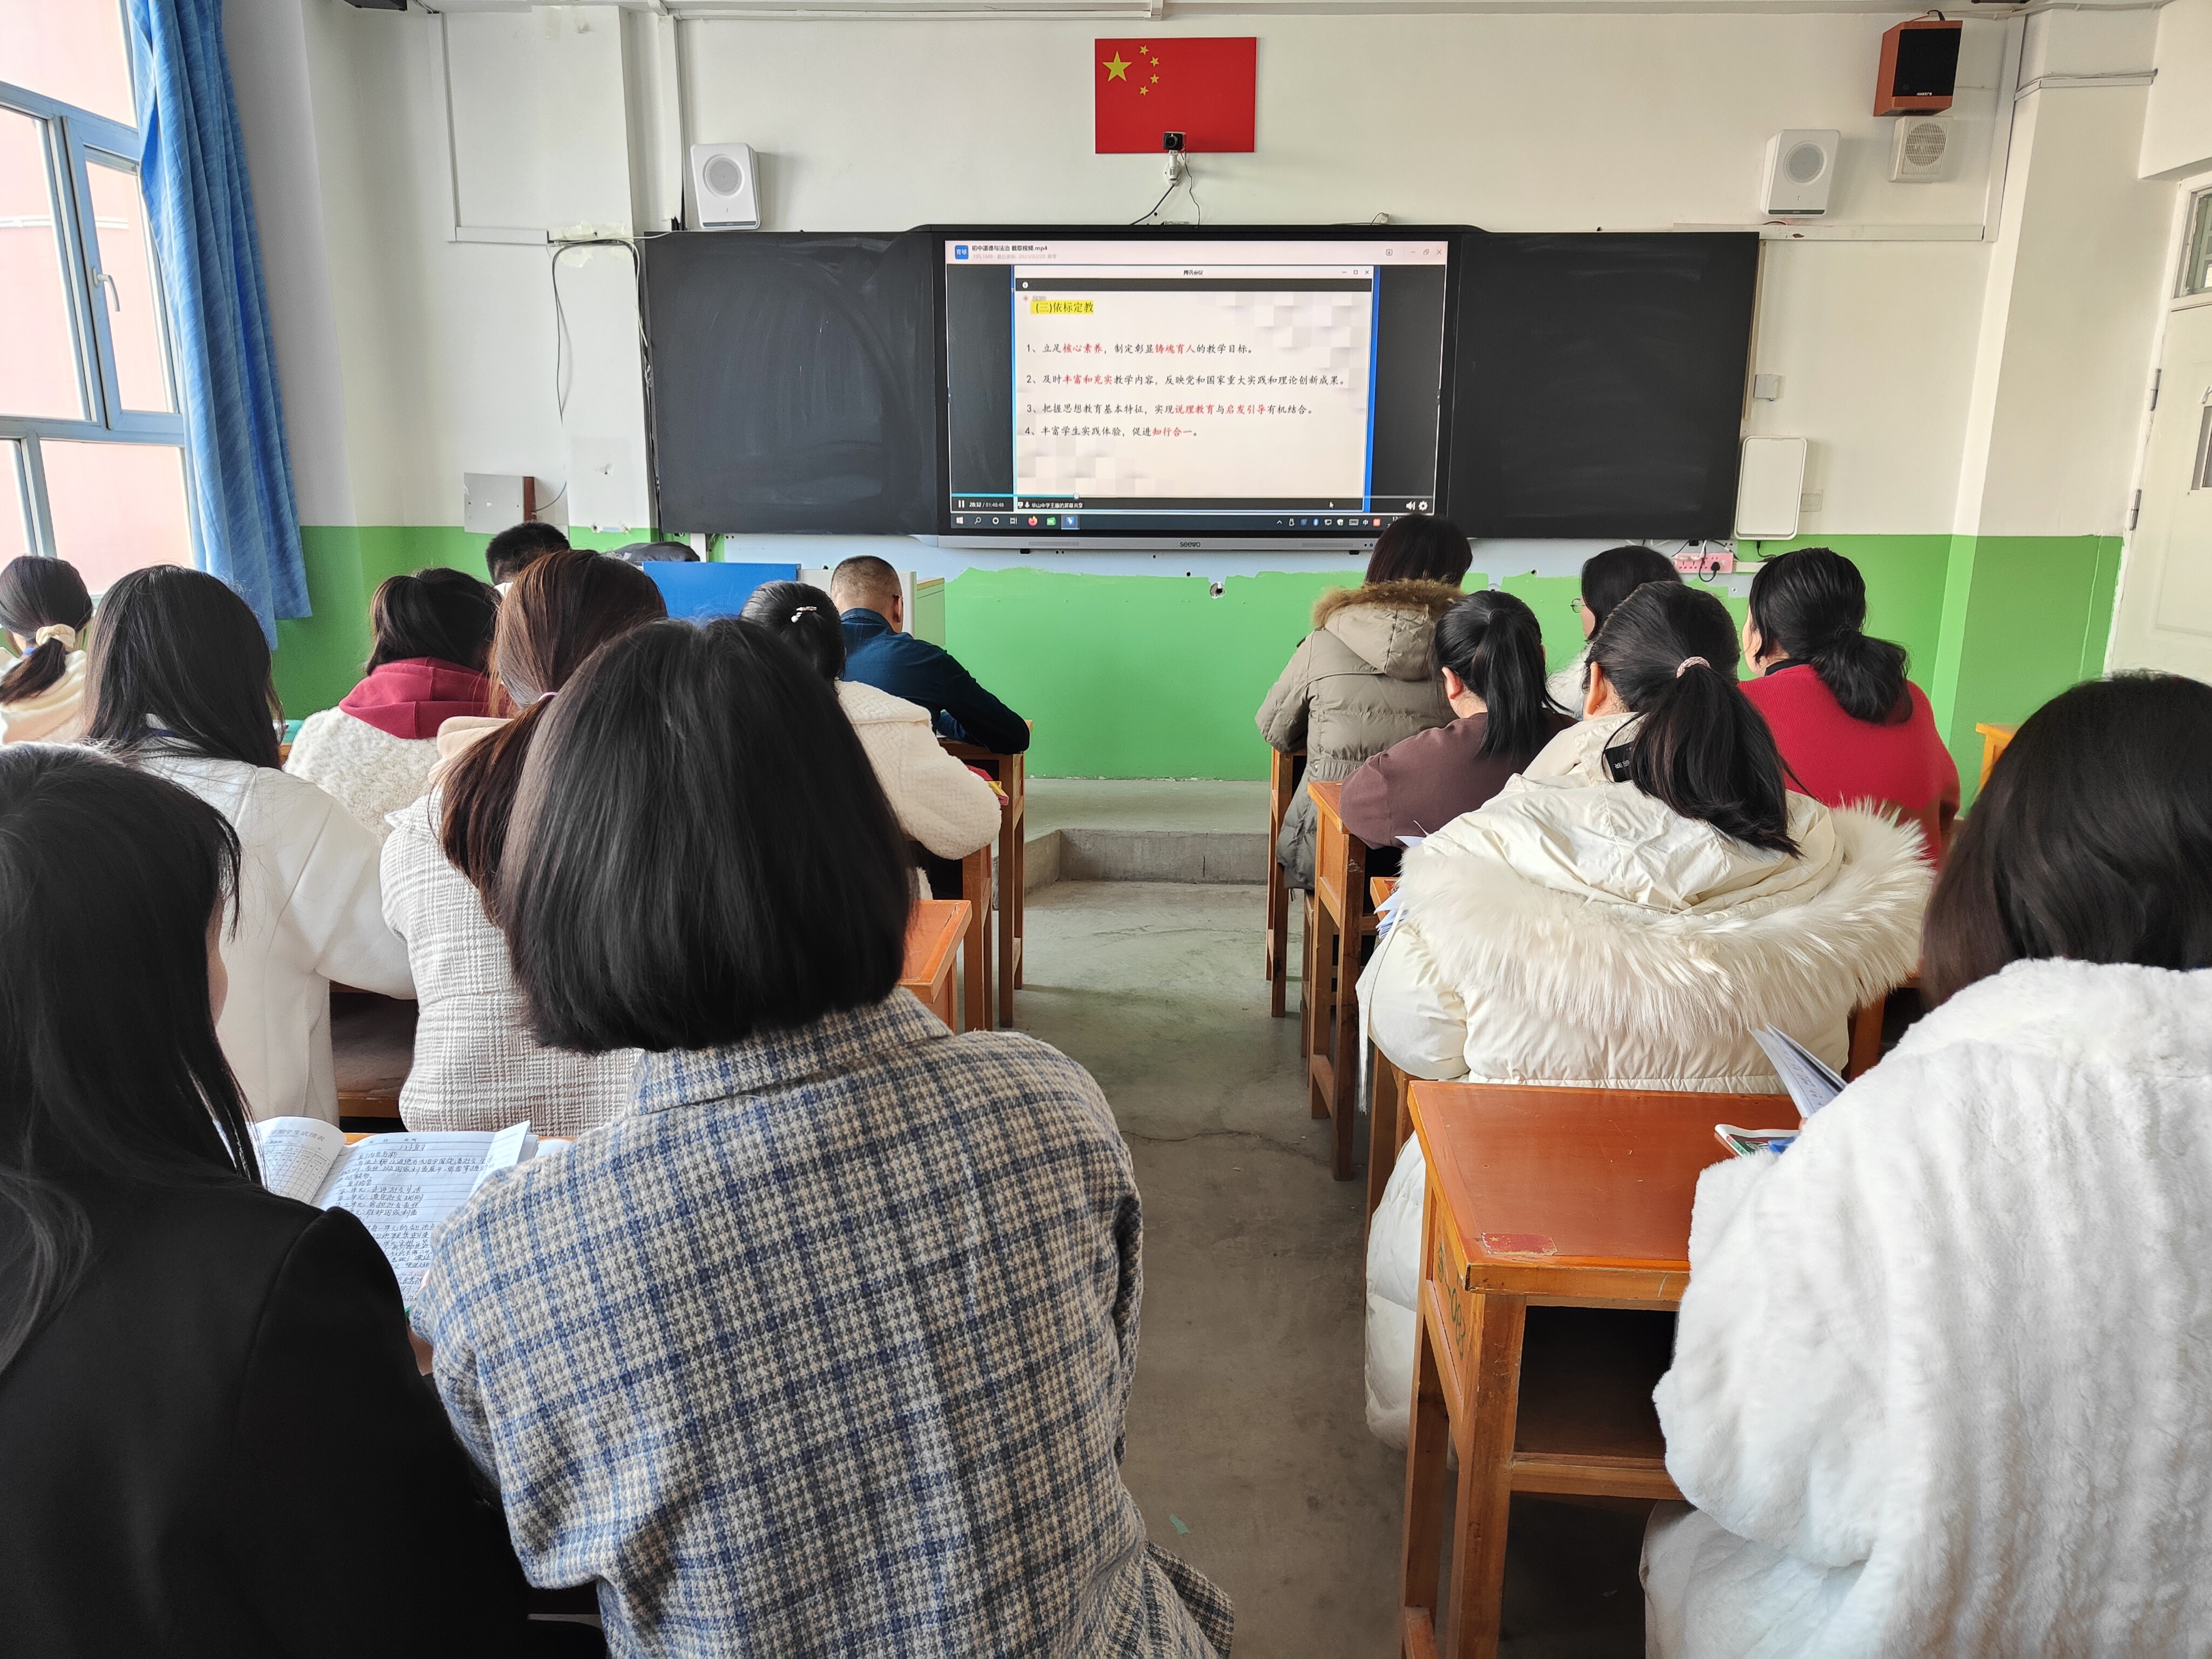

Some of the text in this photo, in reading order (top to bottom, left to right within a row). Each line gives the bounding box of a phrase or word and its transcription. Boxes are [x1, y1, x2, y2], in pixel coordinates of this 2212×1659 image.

[1036, 302, 1093, 313] (三)依标定教
